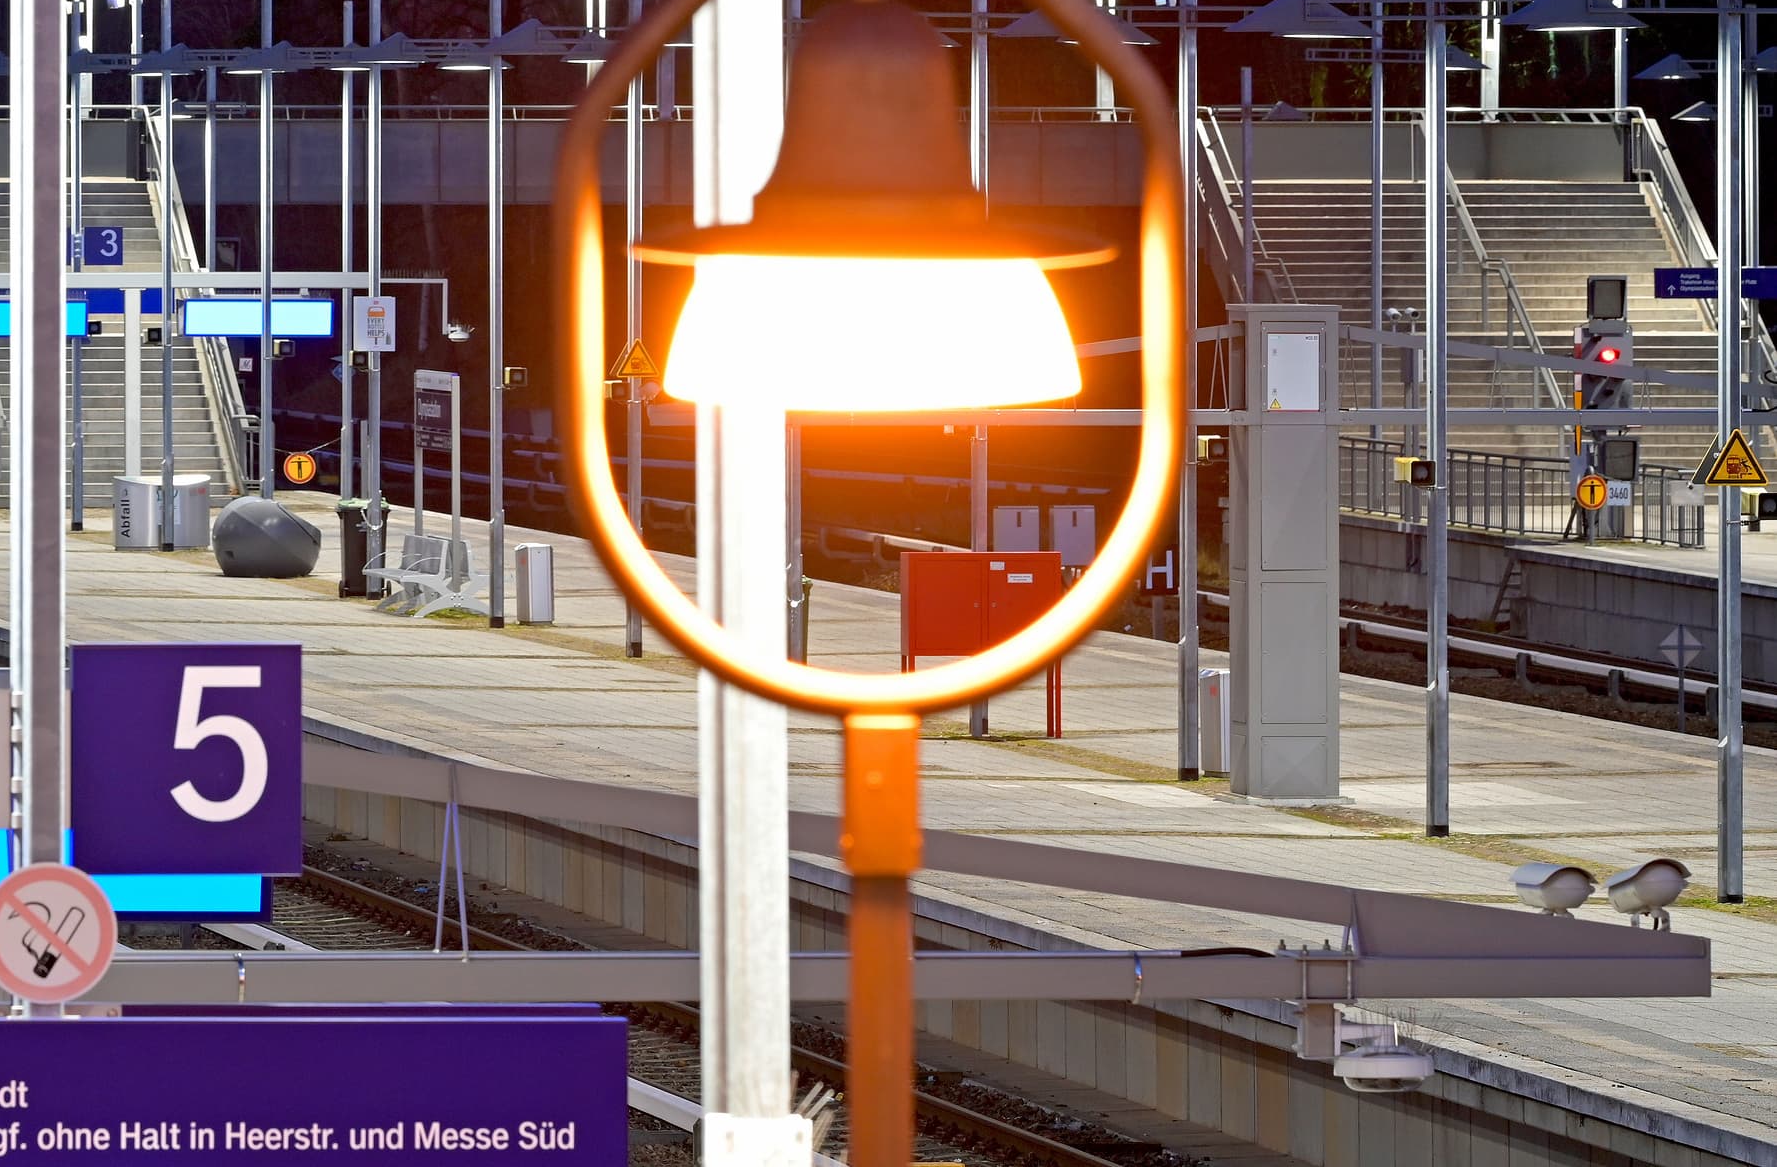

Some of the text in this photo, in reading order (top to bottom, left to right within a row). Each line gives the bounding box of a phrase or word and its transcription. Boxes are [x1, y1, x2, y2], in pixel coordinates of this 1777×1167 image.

[100, 229, 118, 257] 3
[1609, 487, 1629, 500] 3460
[120, 499, 131, 538] Abfall
[1146, 550, 1173, 589] H
[170, 665, 269, 823] 5
[37, 1121, 111, 1151] ohne
[120, 1121, 181, 1151] Halt
[189, 1121, 215, 1150] in
[225, 1121, 339, 1151] Heerstr.
[349, 1121, 404, 1150] und
[414, 1121, 510, 1150] Messe
[518, 1121, 575, 1150] Süd
